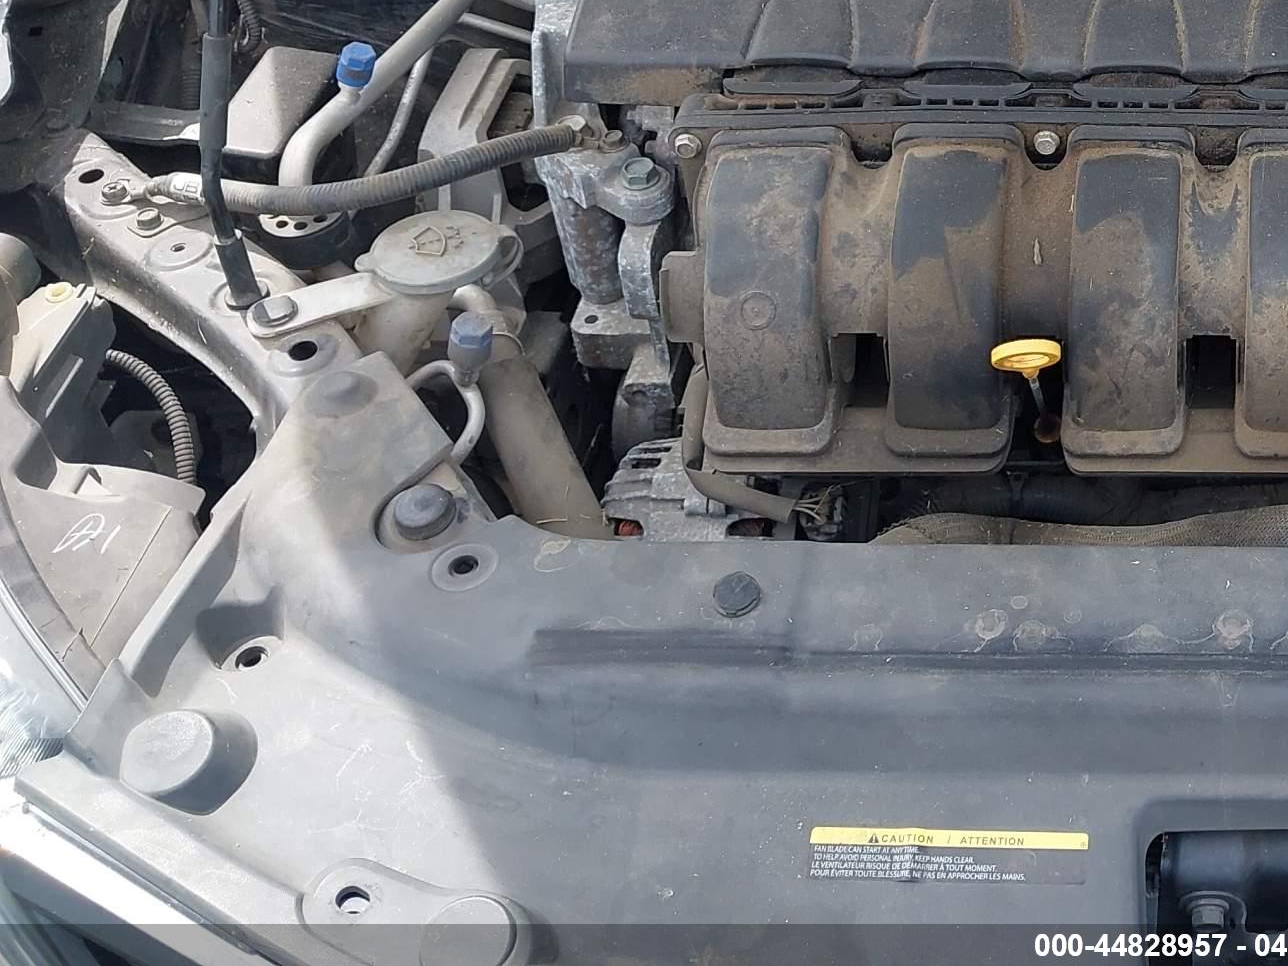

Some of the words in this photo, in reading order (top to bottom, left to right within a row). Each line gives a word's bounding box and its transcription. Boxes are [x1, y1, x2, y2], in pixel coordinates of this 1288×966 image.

[881, 834, 934, 844] CAUTION
[960, 836, 1025, 846] ATTENTION
[814, 845, 826, 853] FAN
[848, 846, 862, 854] CAN
[813, 853, 822, 861] TO
[860, 854, 891, 862] PERSONAL
[821, 862, 866, 870] VENTILATEUR
[866, 863, 890, 871] RISQUE
[810, 869, 830, 877] POUR
[936, 871, 947, 879] EN
[947, 872, 989, 880] APPROCHER
[989, 873, 1001, 881] LES
